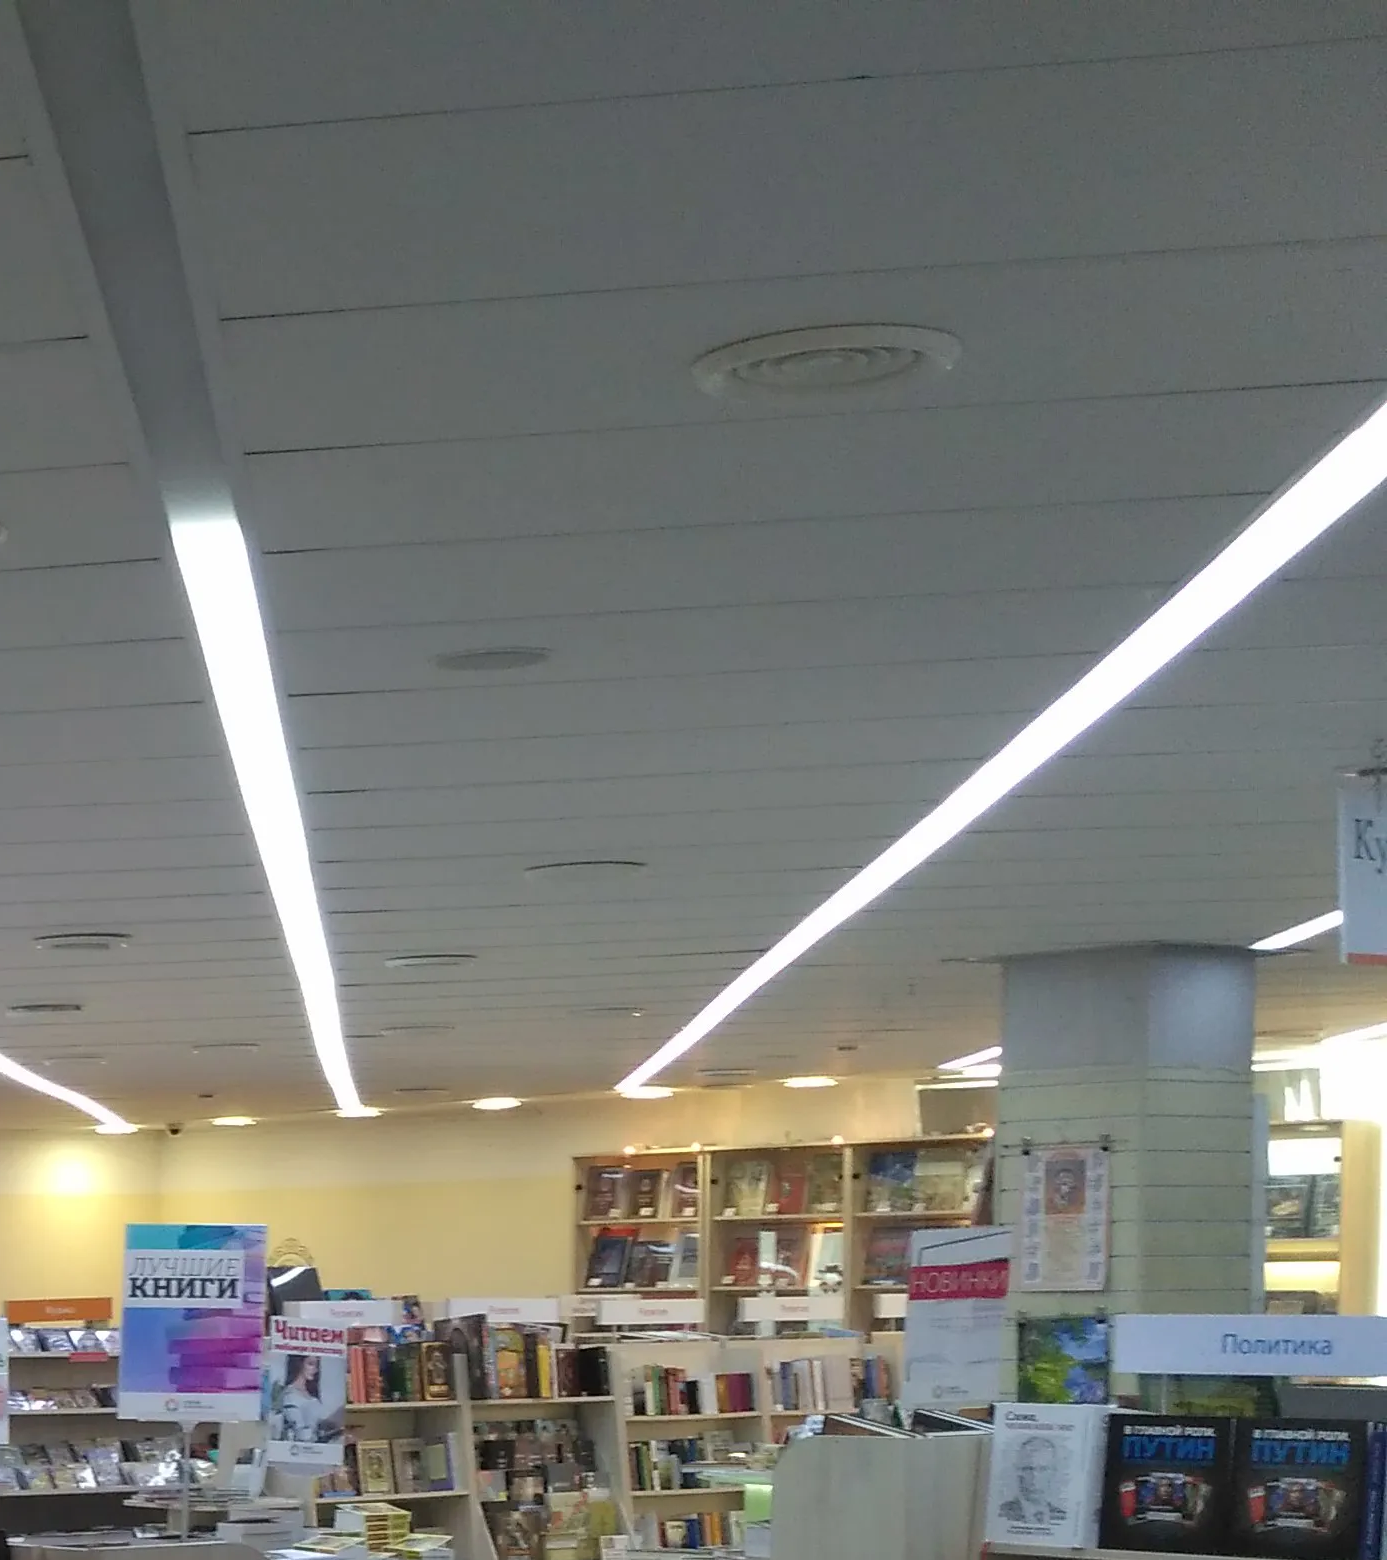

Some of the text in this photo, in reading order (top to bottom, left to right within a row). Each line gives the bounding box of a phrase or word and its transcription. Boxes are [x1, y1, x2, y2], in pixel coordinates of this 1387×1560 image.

[128, 1256, 242, 1279] ЛУЧШИЕ
[129, 1278, 241, 1300] КНИГИ
[911, 1266, 1007, 1296] НОВИНКИ
[274, 1320, 345, 1344] Читаем
[1220, 1333, 1334, 1356] Политика
[1121, 1436, 1216, 1462] ПУТИН
